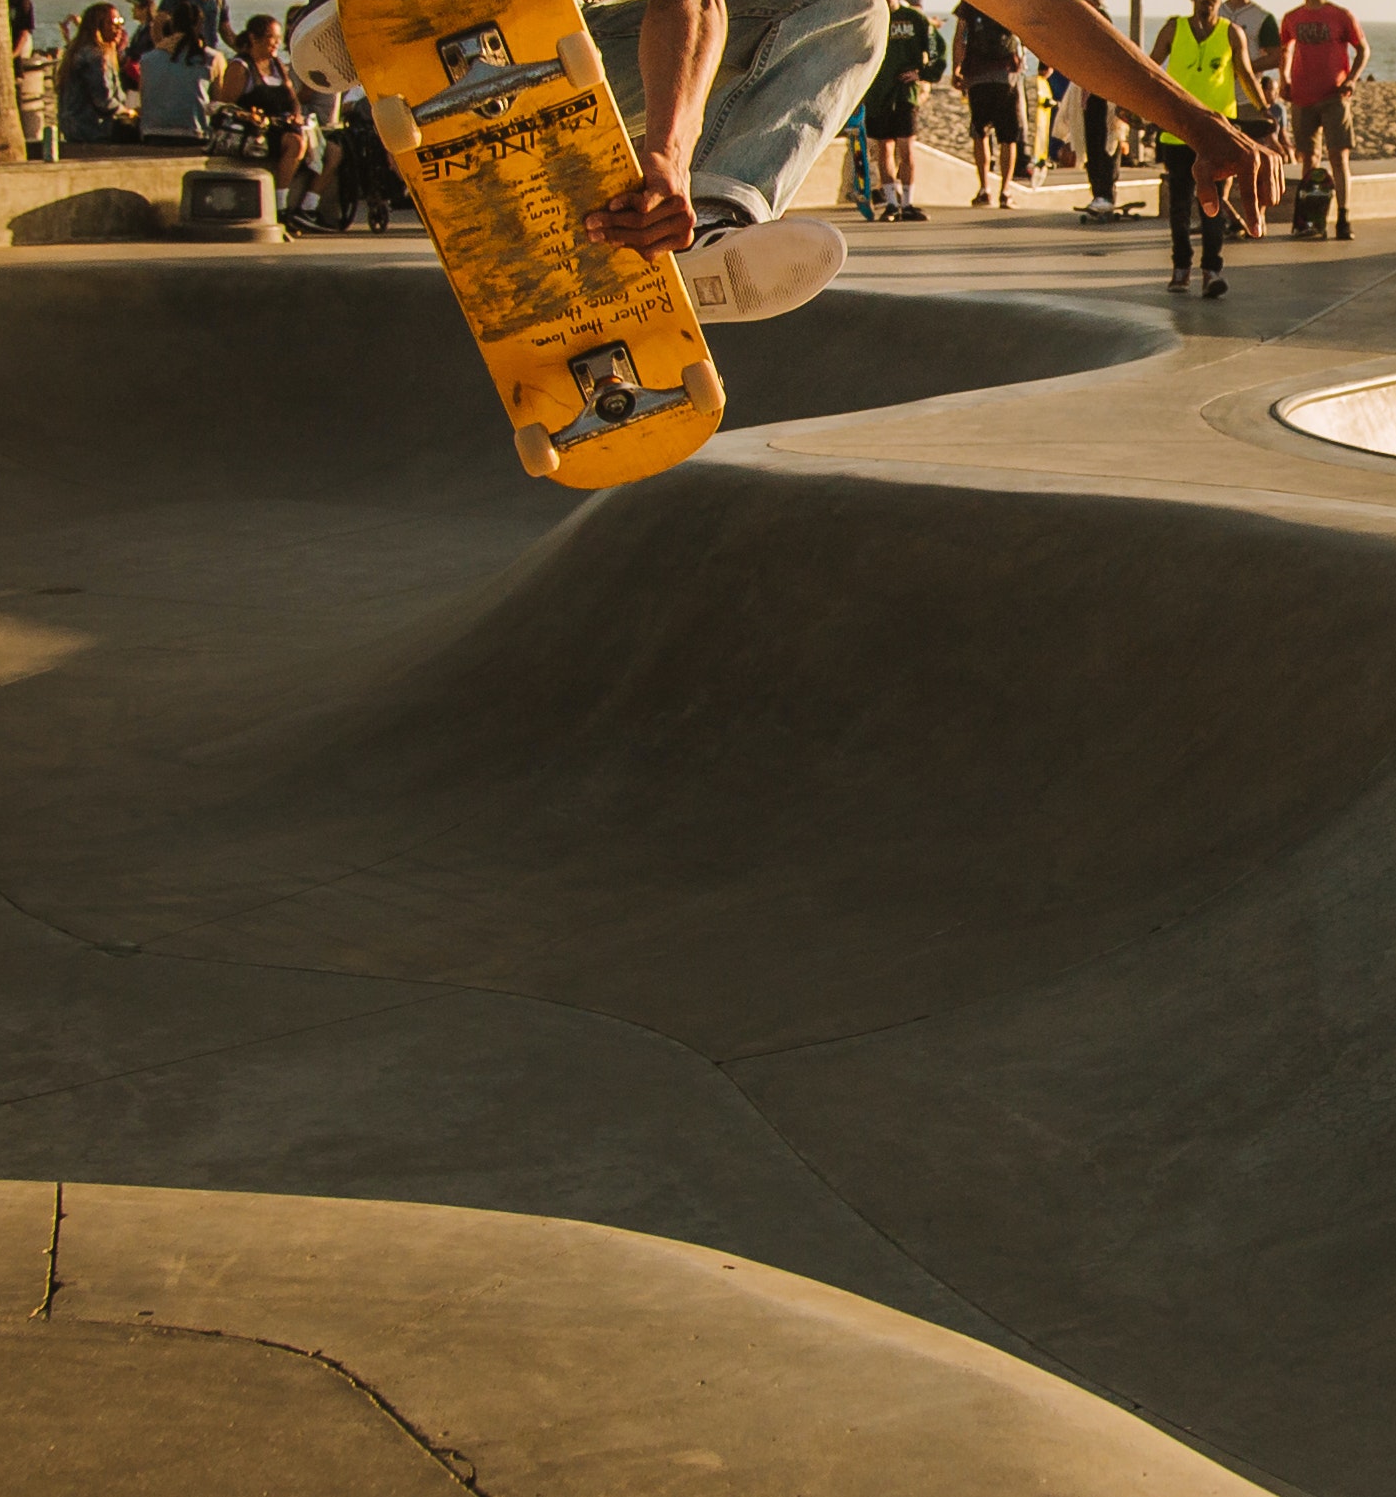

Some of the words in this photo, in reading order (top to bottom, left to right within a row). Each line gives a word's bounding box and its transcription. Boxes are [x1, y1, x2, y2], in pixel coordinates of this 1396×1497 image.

[609, 291, 675, 324] Rather
[569, 317, 604, 336] than
[530, 331, 567, 349] love,
